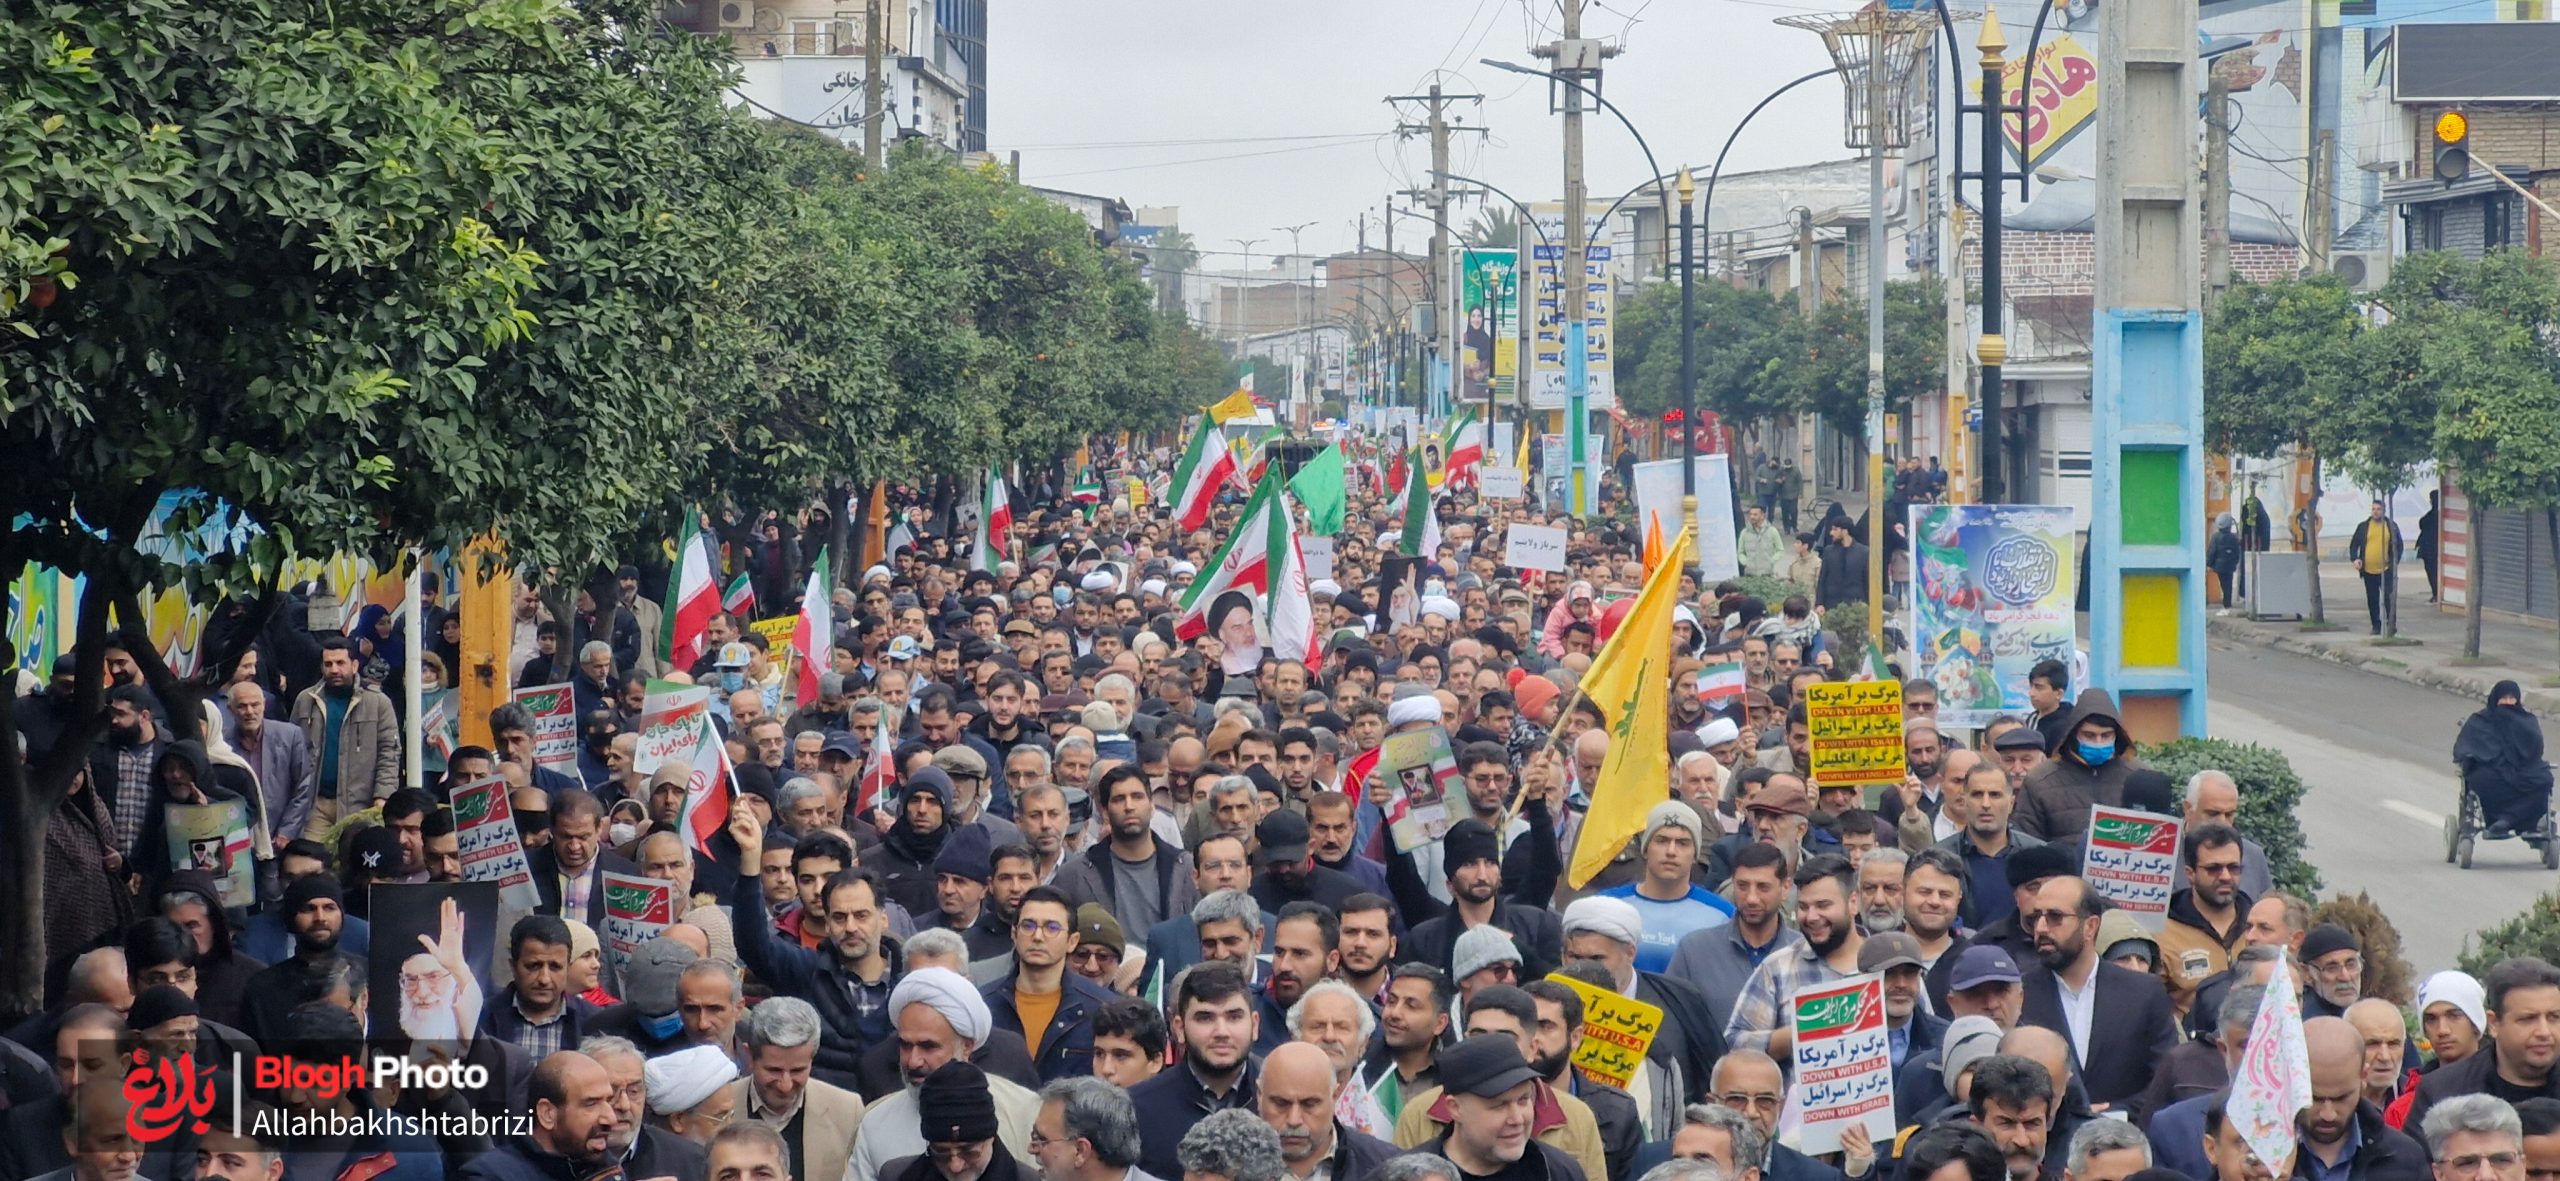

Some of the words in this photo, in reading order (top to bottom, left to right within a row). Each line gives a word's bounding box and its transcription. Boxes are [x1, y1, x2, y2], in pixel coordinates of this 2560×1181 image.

[823, 72, 860, 92] خانگی
[2003, 56, 2096, 146] هادی
[1809, 685, 1853, 705] آمریکا
[1855, 689, 1868, 704] بر
[1870, 686, 1899, 703] مرگ
[549, 722, 556, 732] بر
[558, 718, 574, 730] مرگ
[1812, 719, 1857, 736] اسرائیل
[1860, 722, 1871, 735] بر
[1874, 718, 1901, 733] مرگ
[553, 744, 560, 753] بر
[561, 740, 575, 751] مرگ
[650, 739, 676, 757] ایران
[1860, 755, 1870, 767] بر
[1874, 750, 1903, 765] مرگ
[484, 833, 493, 847] بر
[493, 825, 514, 842] مرگ
[502, 856, 524, 872] مرگ
[2090, 850, 2132, 869] آمریکا
[2130, 859, 2143, 873] بر
[2145, 858, 2172, 874] مرگ
[493, 863, 501, 877] بر
[2089, 868, 2116, 878] DOWN
[2119, 871, 2142, 881] WITH
[2129, 888, 2140, 899] بر
[2142, 886, 2168, 901] مرگ
[2134, 902, 2164, 911] ISRAEL
[636, 931, 643, 943] بر
[1592, 1009, 1615, 1025] بر
[1617, 1012, 1653, 1034] مرگ
[1799, 1038, 1846, 1068] آمریکا
[1847, 1043, 1860, 1063] بر
[1862, 1034, 1885, 1056] مرگ
[1578, 1049, 1599, 1065] بر
[1602, 1052, 1635, 1073] مرگ
[1802, 1070, 1835, 1083] DOWN
[1838, 1062, 1862, 1078] WITH
[1863, 1058, 1887, 1072] U.S.A
[1853, 1081, 1864, 1100] بر
[1866, 1073, 1889, 1093] مرگ
[1803, 1080, 1852, 1107] اسرائیل
[1805, 1110, 1834, 1122] DOWN
[1837, 1104, 1860, 1117] WITH
[1861, 1097, 1889, 1111] ISRAEL
